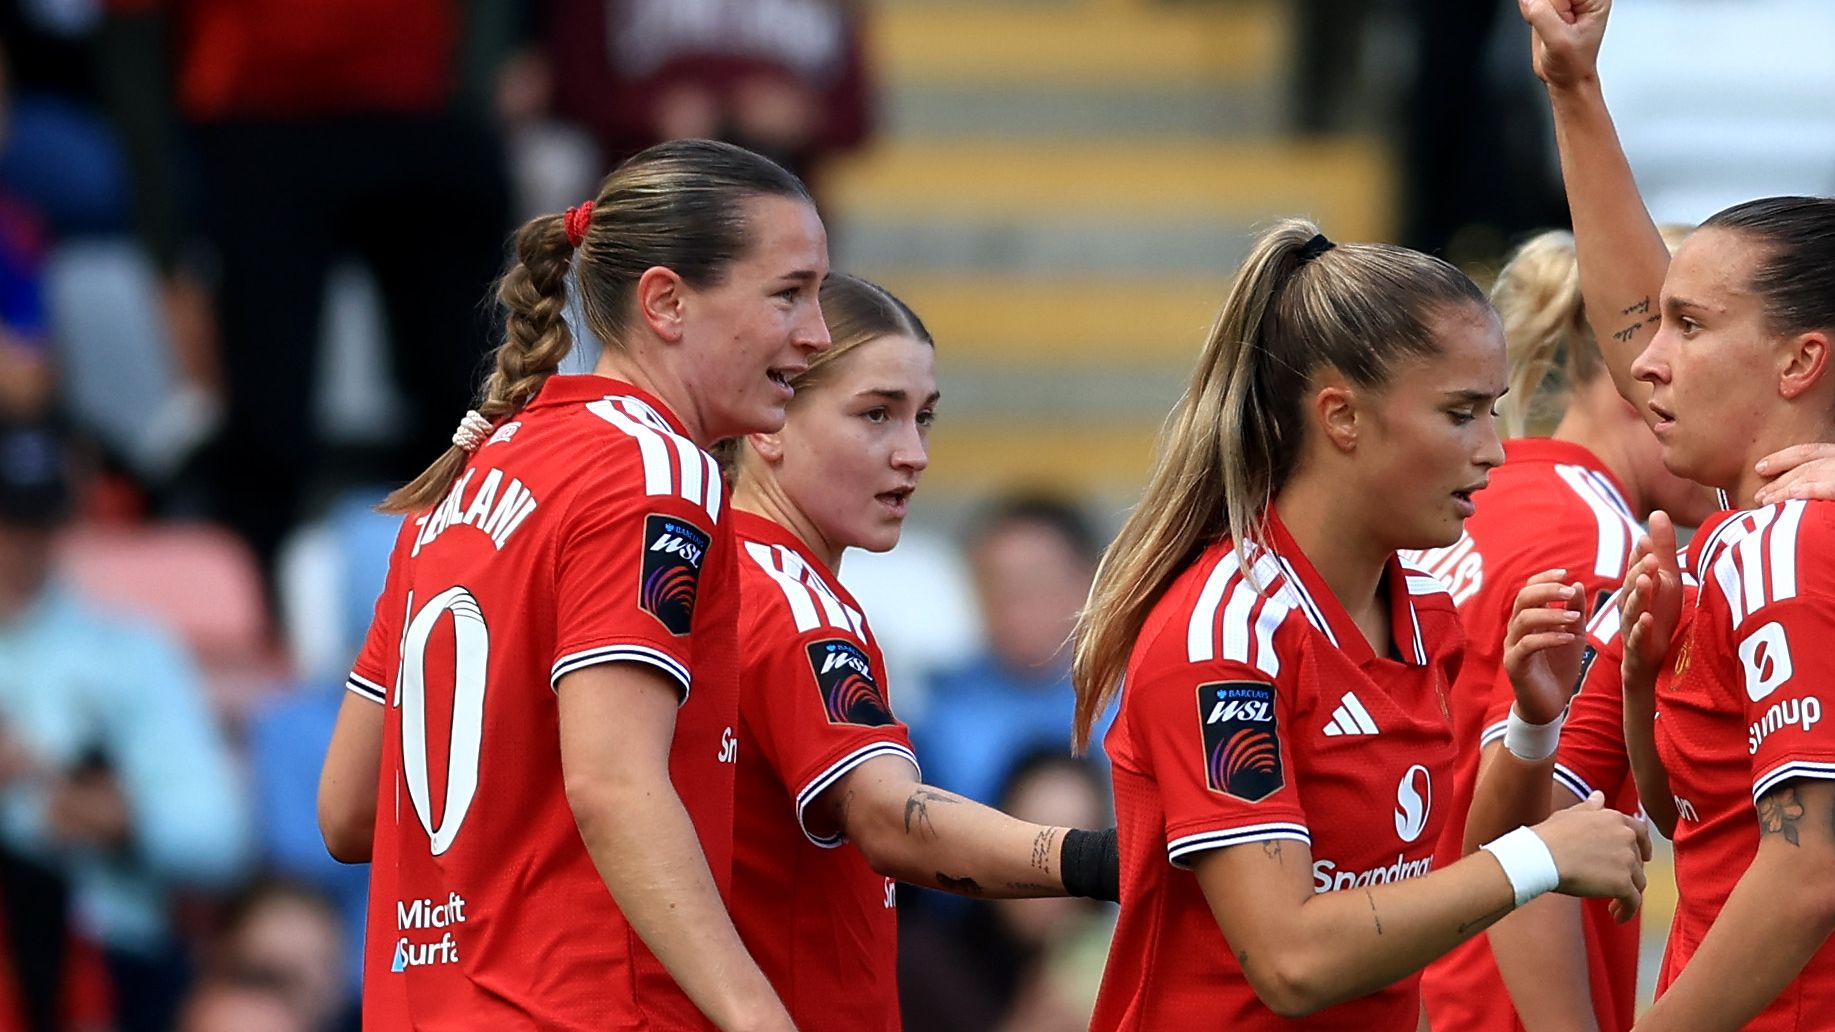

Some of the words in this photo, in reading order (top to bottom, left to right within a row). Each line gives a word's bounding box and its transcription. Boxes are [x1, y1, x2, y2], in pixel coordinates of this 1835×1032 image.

[650, 533, 702, 569] WSL
[820, 652, 873, 681] WSL
[1206, 700, 1273, 725] WSL
[1312, 853, 1434, 893] Snapdrag
